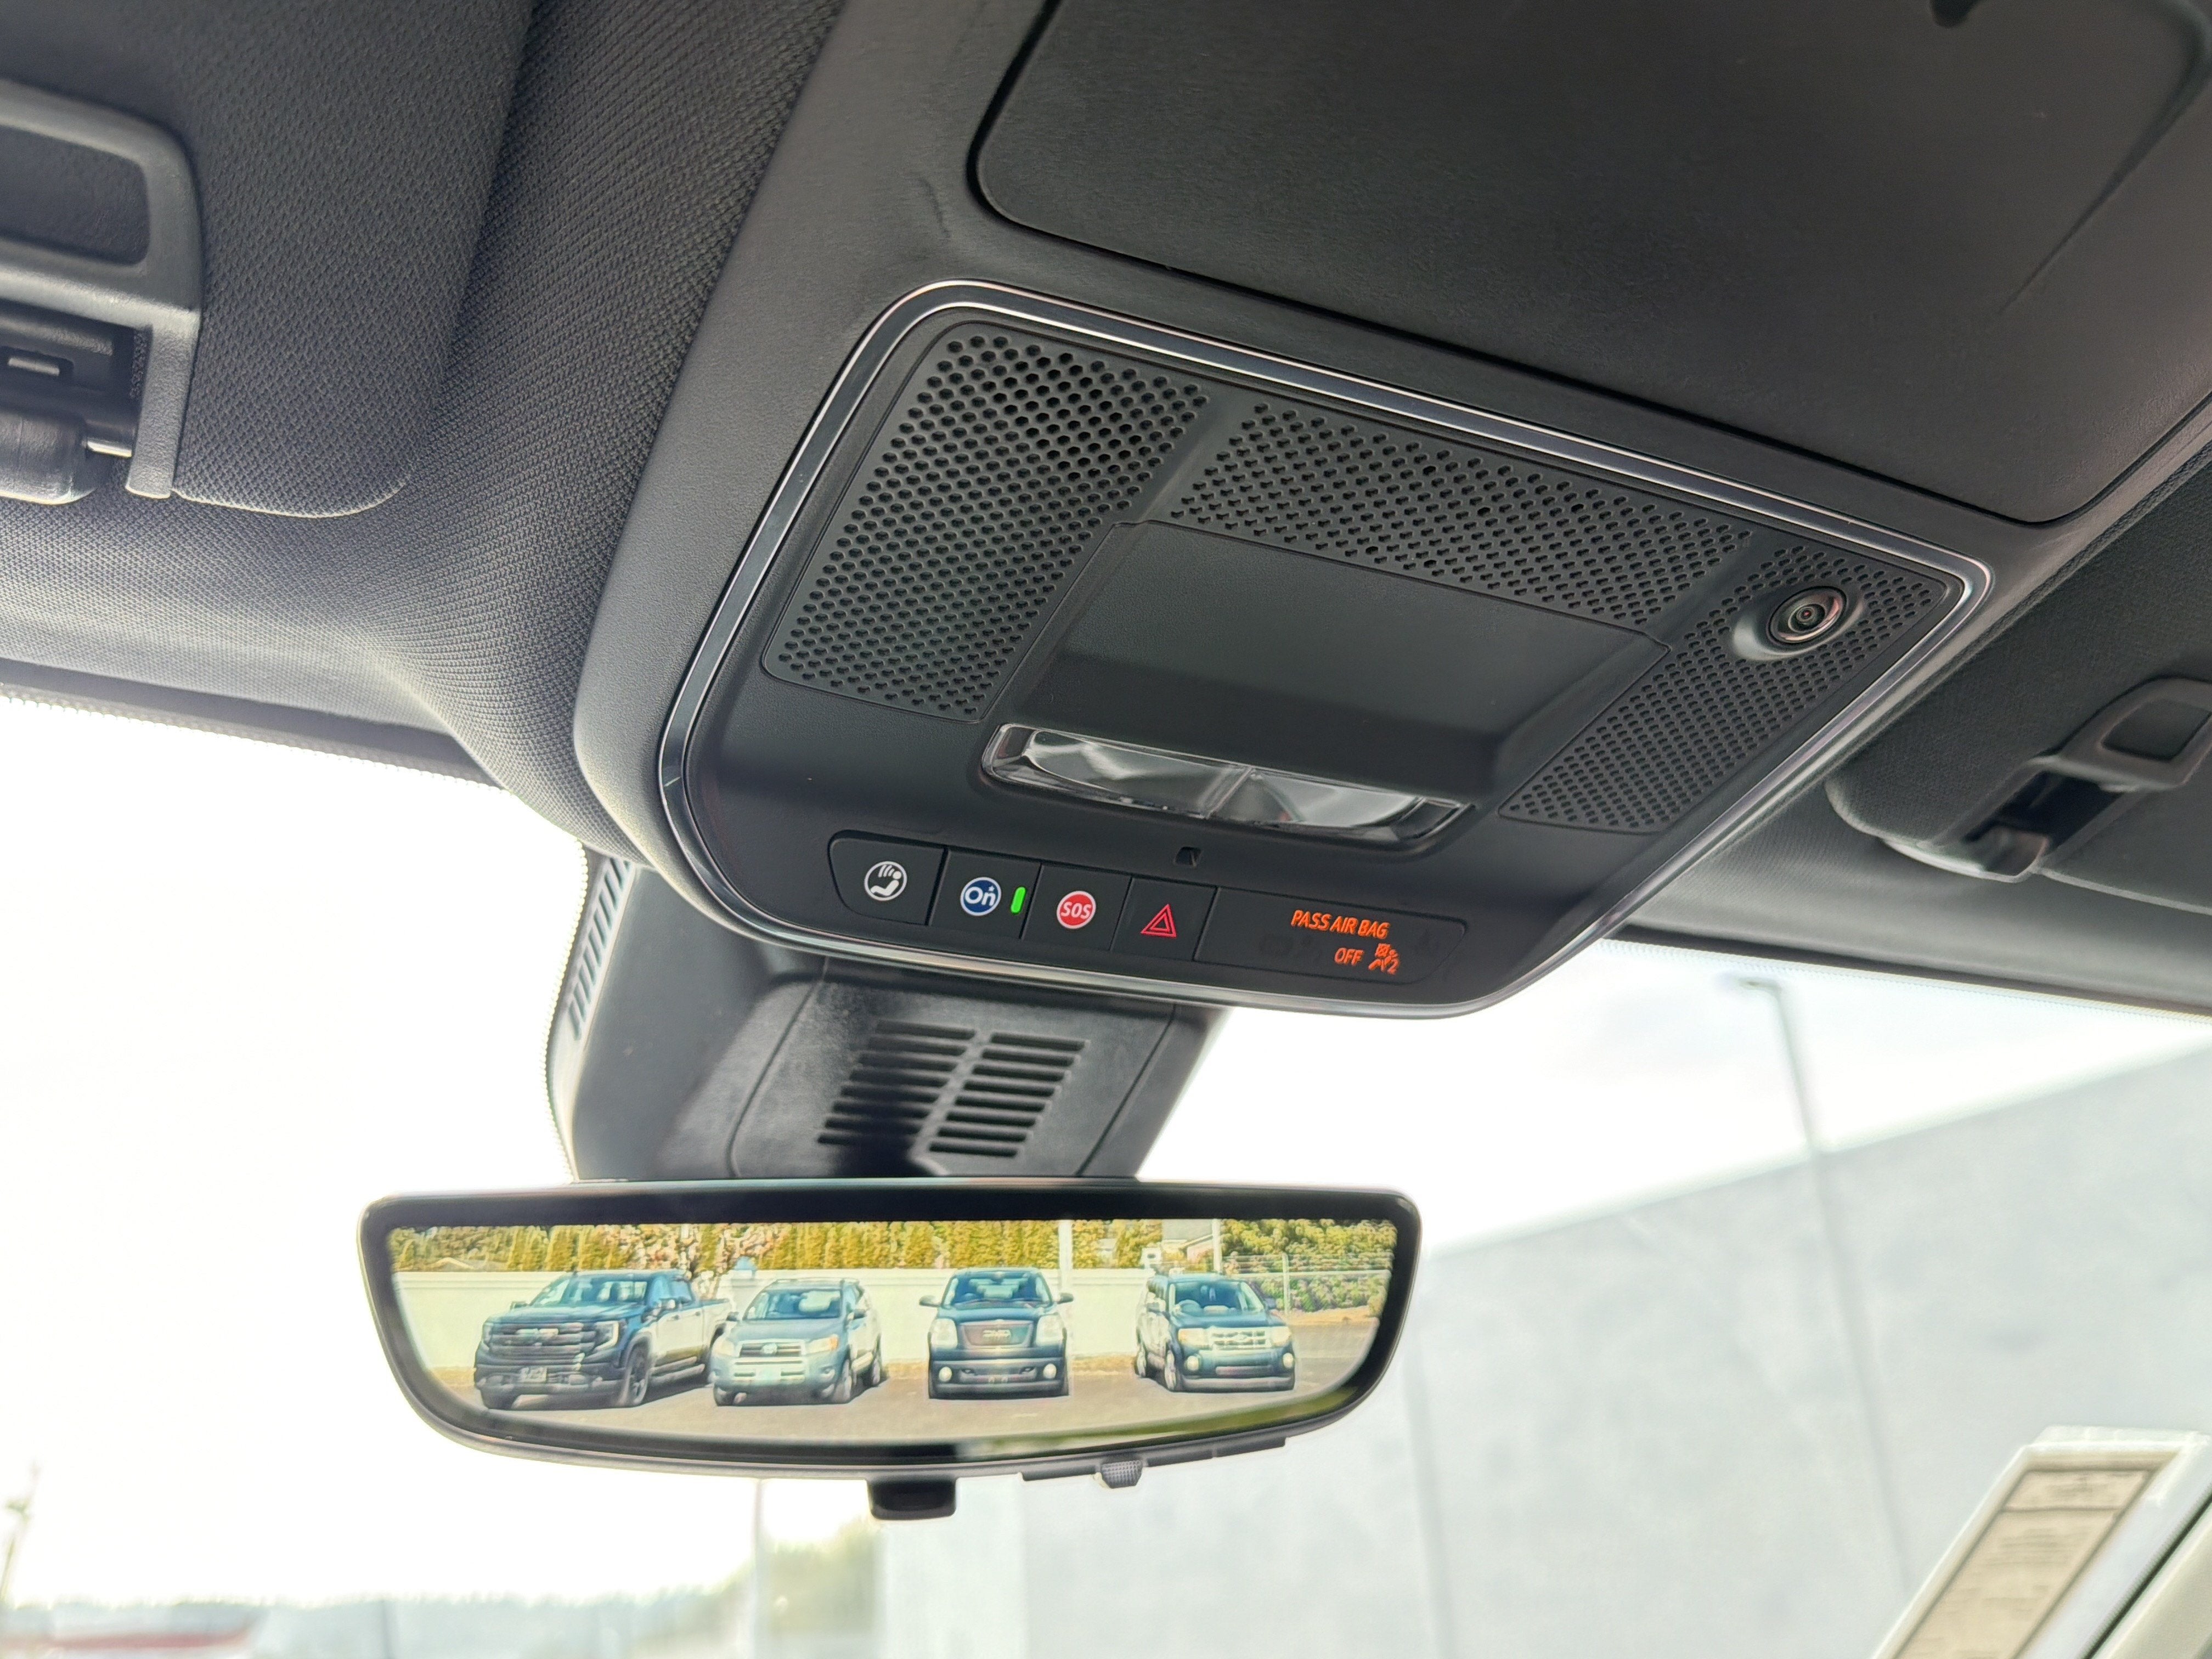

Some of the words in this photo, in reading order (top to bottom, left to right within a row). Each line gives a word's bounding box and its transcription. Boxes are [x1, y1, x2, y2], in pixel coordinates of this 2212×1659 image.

[964, 885, 996, 906] On
[1060, 901, 1092, 919] SOS
[1291, 909, 1332, 931] PASS
[1330, 916, 1358, 934] AIR
[1358, 919, 1390, 939] BAG
[1334, 947, 1364, 966] OFF
